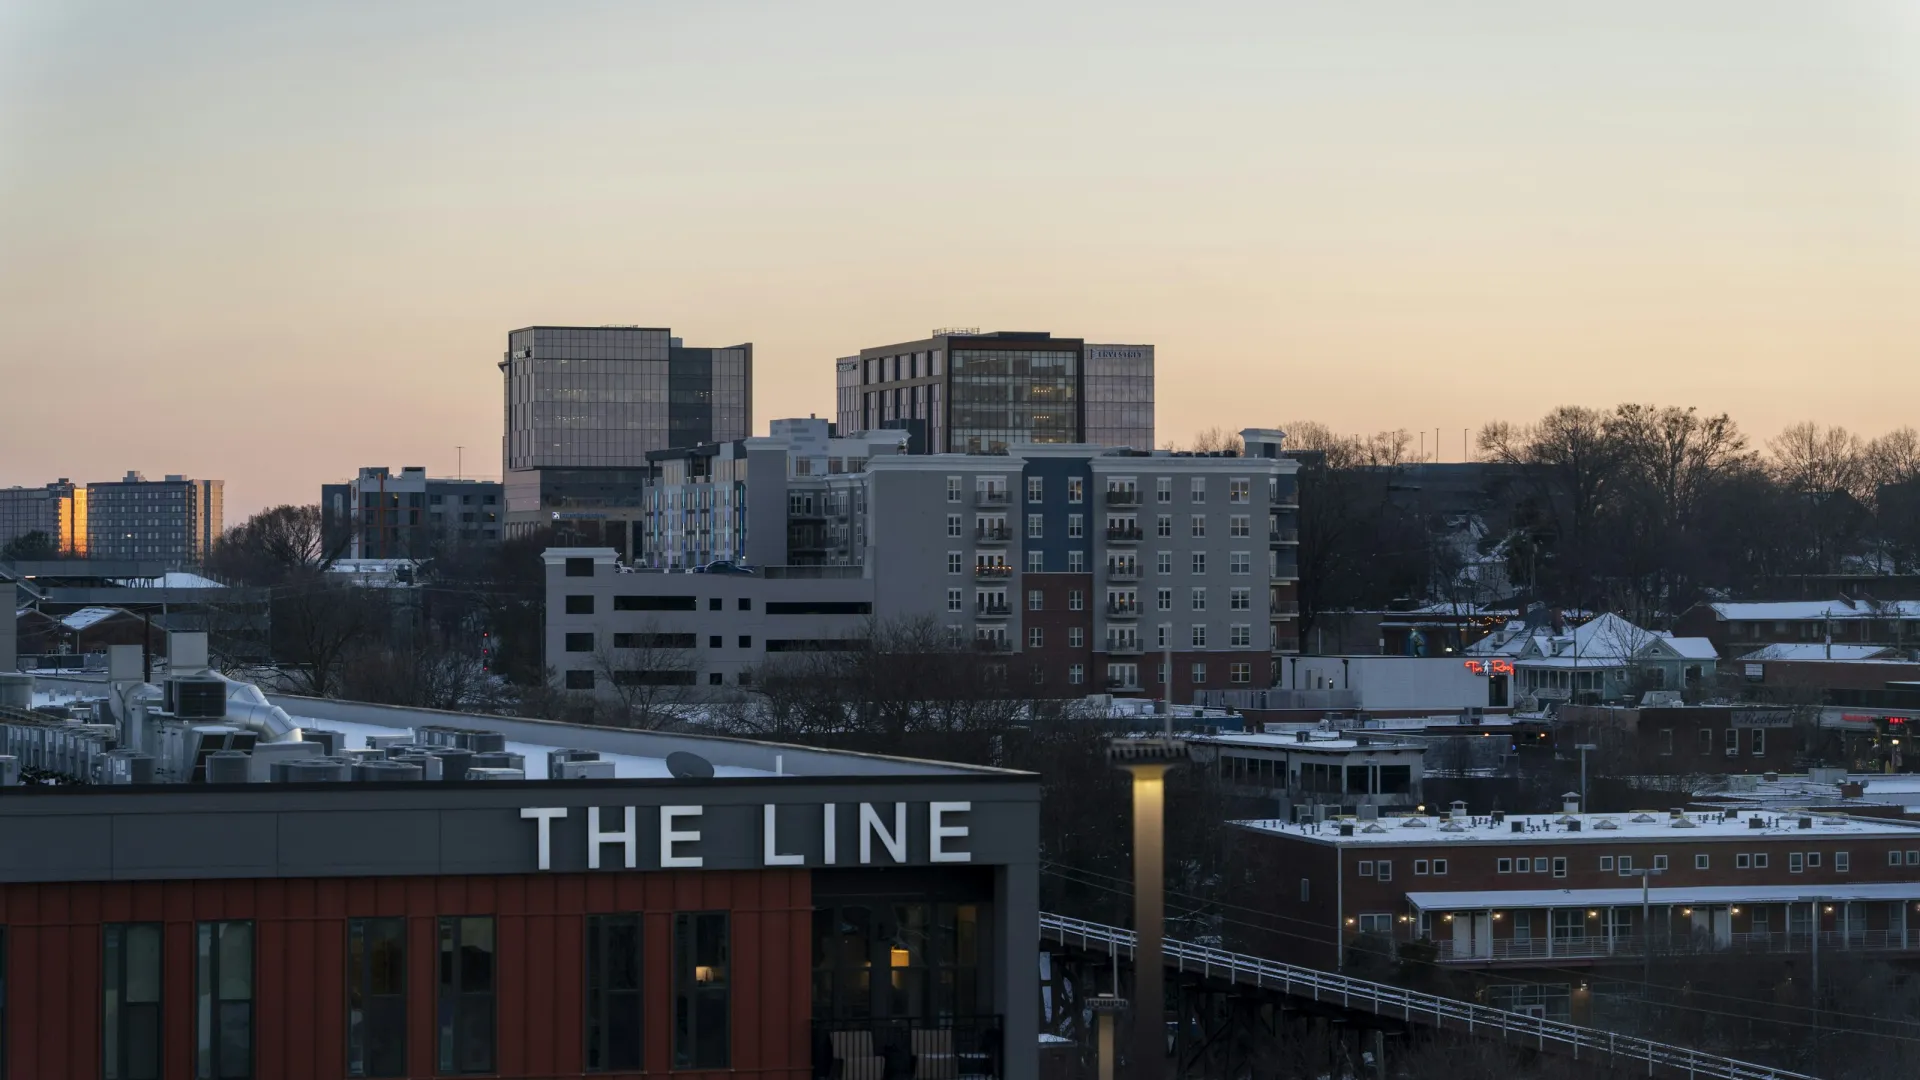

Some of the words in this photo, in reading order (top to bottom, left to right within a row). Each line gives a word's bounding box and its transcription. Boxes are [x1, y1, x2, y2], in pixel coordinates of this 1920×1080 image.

[1464, 660, 1483, 673] Tin
[1491, 659, 1515, 676] Roof
[520, 805, 703, 870] THE
[764, 801, 971, 866] LINE
